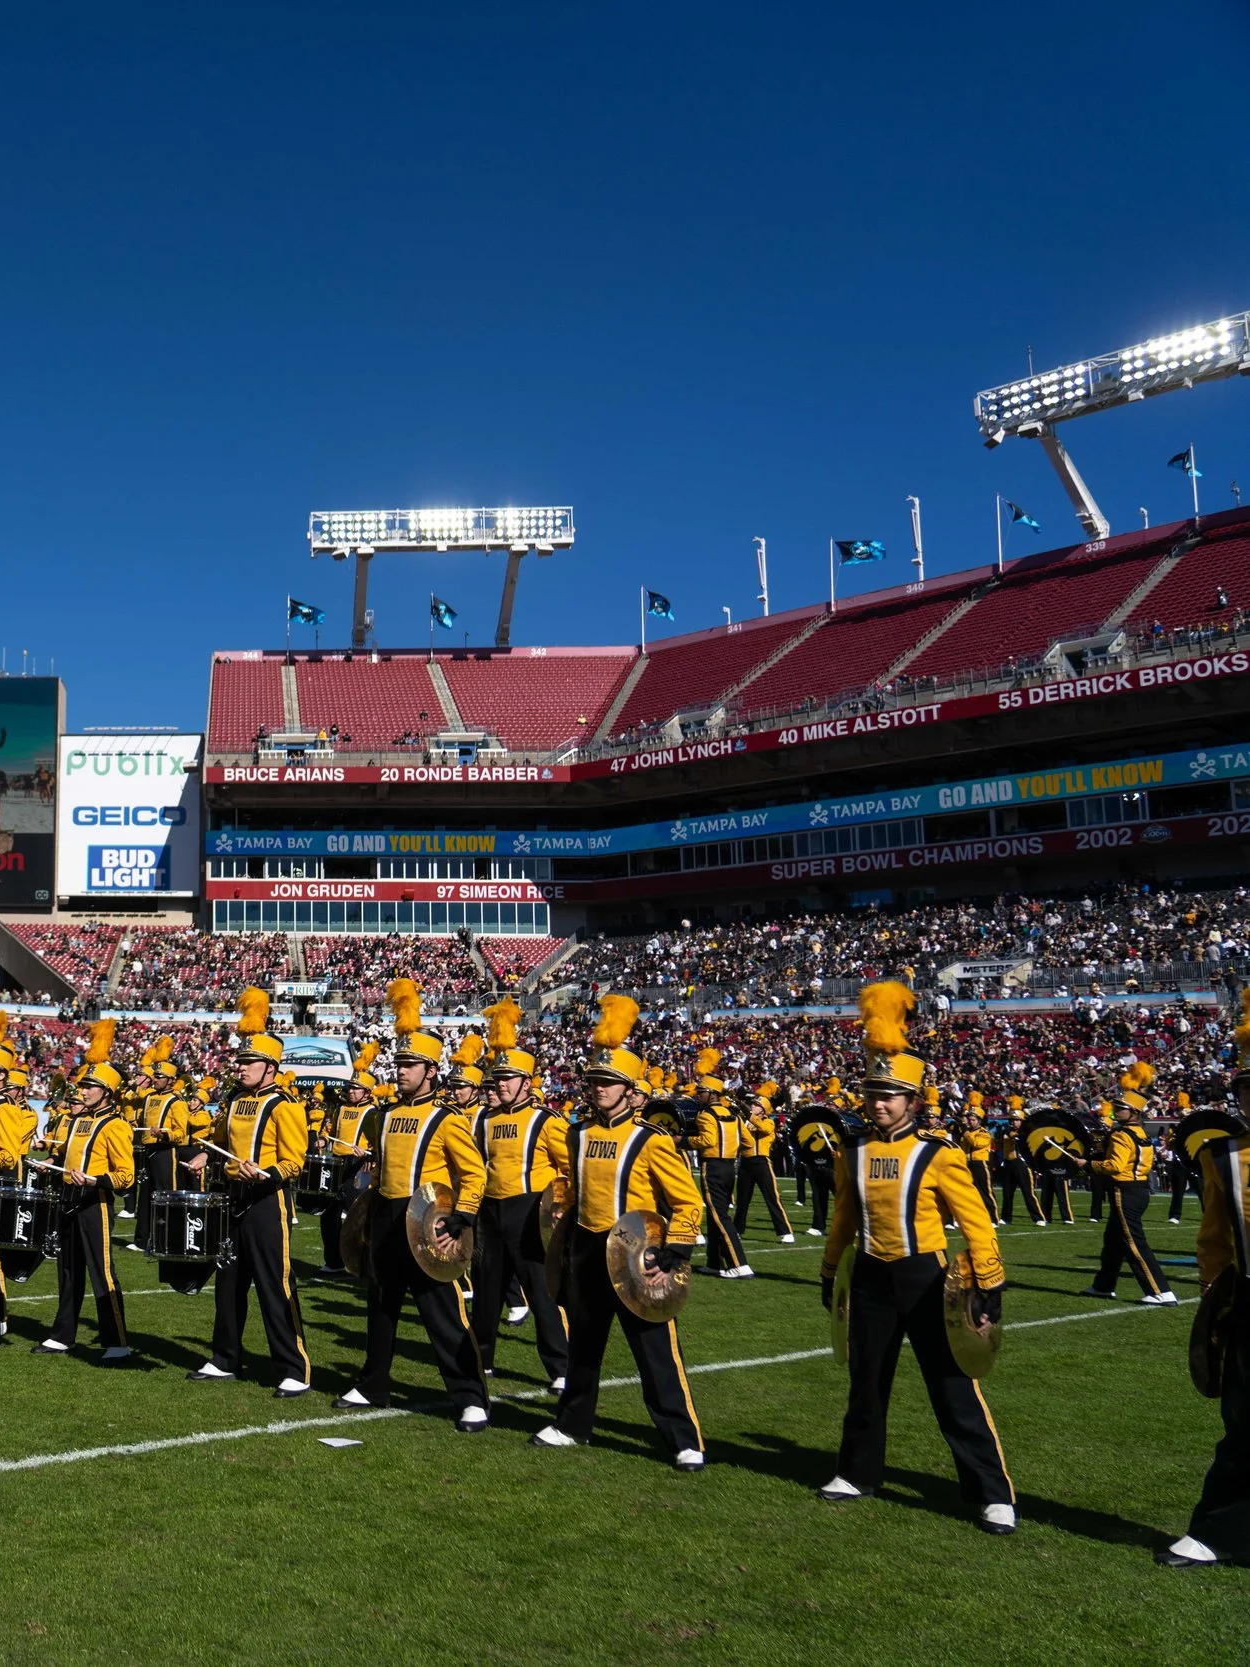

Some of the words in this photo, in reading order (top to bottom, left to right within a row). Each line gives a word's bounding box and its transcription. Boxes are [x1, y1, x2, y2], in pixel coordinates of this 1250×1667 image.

[1085, 541, 1106, 553] 339
[530, 647, 547, 657] 342
[997, 691, 1023, 710] 55
[1028, 672, 1133, 705] DERRICK
[1139, 653, 1249, 688] BROOKS
[778, 728, 799, 746] 40
[802, 719, 849, 742] MIKE
[852, 704, 942, 735] ALSTOTT
[66, 749, 185, 777] Publix
[610, 756, 627, 772] 47
[631, 751, 674, 771] JOHN
[677, 739, 732, 763] LYNCH
[223, 767, 279, 782] BRUCE
[283, 767, 345, 782] ARIANS
[380, 767, 400, 782] 20
[403, 764, 463, 782] RONDÉ
[467, 767, 538, 781] BARBER
[831, 800, 886, 819] TAMPA
[890, 794, 922, 812] BAY
[938, 788, 966, 809] GO
[970, 780, 1013, 805] AND
[1016, 771, 1087, 799] YOU'LL
[1091, 760, 1164, 790] KNOW
[72, 805, 187, 827] GEICO
[689, 818, 738, 835] TAMPA
[741, 813, 769, 830] BAY
[1206, 814, 1250, 837] 202
[235, 837, 283, 849] TAMPA
[287, 837, 314, 849] BAY
[326, 835, 349, 852] GO
[352, 835, 386, 852] AND
[388, 835, 441, 853] YOU'LL
[444, 835, 496, 853] KNOW
[533, 836, 584, 850] TAMPA
[587, 835, 612, 849] BAY
[1075, 827, 1133, 850] 2002
[101, 848, 156, 869] BUD
[771, 858, 836, 881] SUPER
[842, 852, 904, 874] BOWL
[908, 836, 1044, 868] CHAMPIONS
[90, 868, 166, 888] LIGHT
[270, 884, 303, 898] JON
[307, 884, 375, 898] GRUDEN
[436, 885, 455, 899] 97
[458, 885, 522, 899] SIMEON
[528, 885, 565, 900] RICE
[962, 964, 1014, 975] METERS
[234, 1100, 260, 1116] IOWA
[341, 1110, 359, 1120] IOWA
[388, 1117, 420, 1135] IOWA
[491, 1123, 518, 1140] IOWA
[585, 1140, 618, 1160] IOWA
[318, 1166, 331, 1190] Pearl
[868, 1157, 900, 1180] IOWA
[14, 1205, 33, 1242] Pearl
[186, 1212, 204, 1252] Pearl
